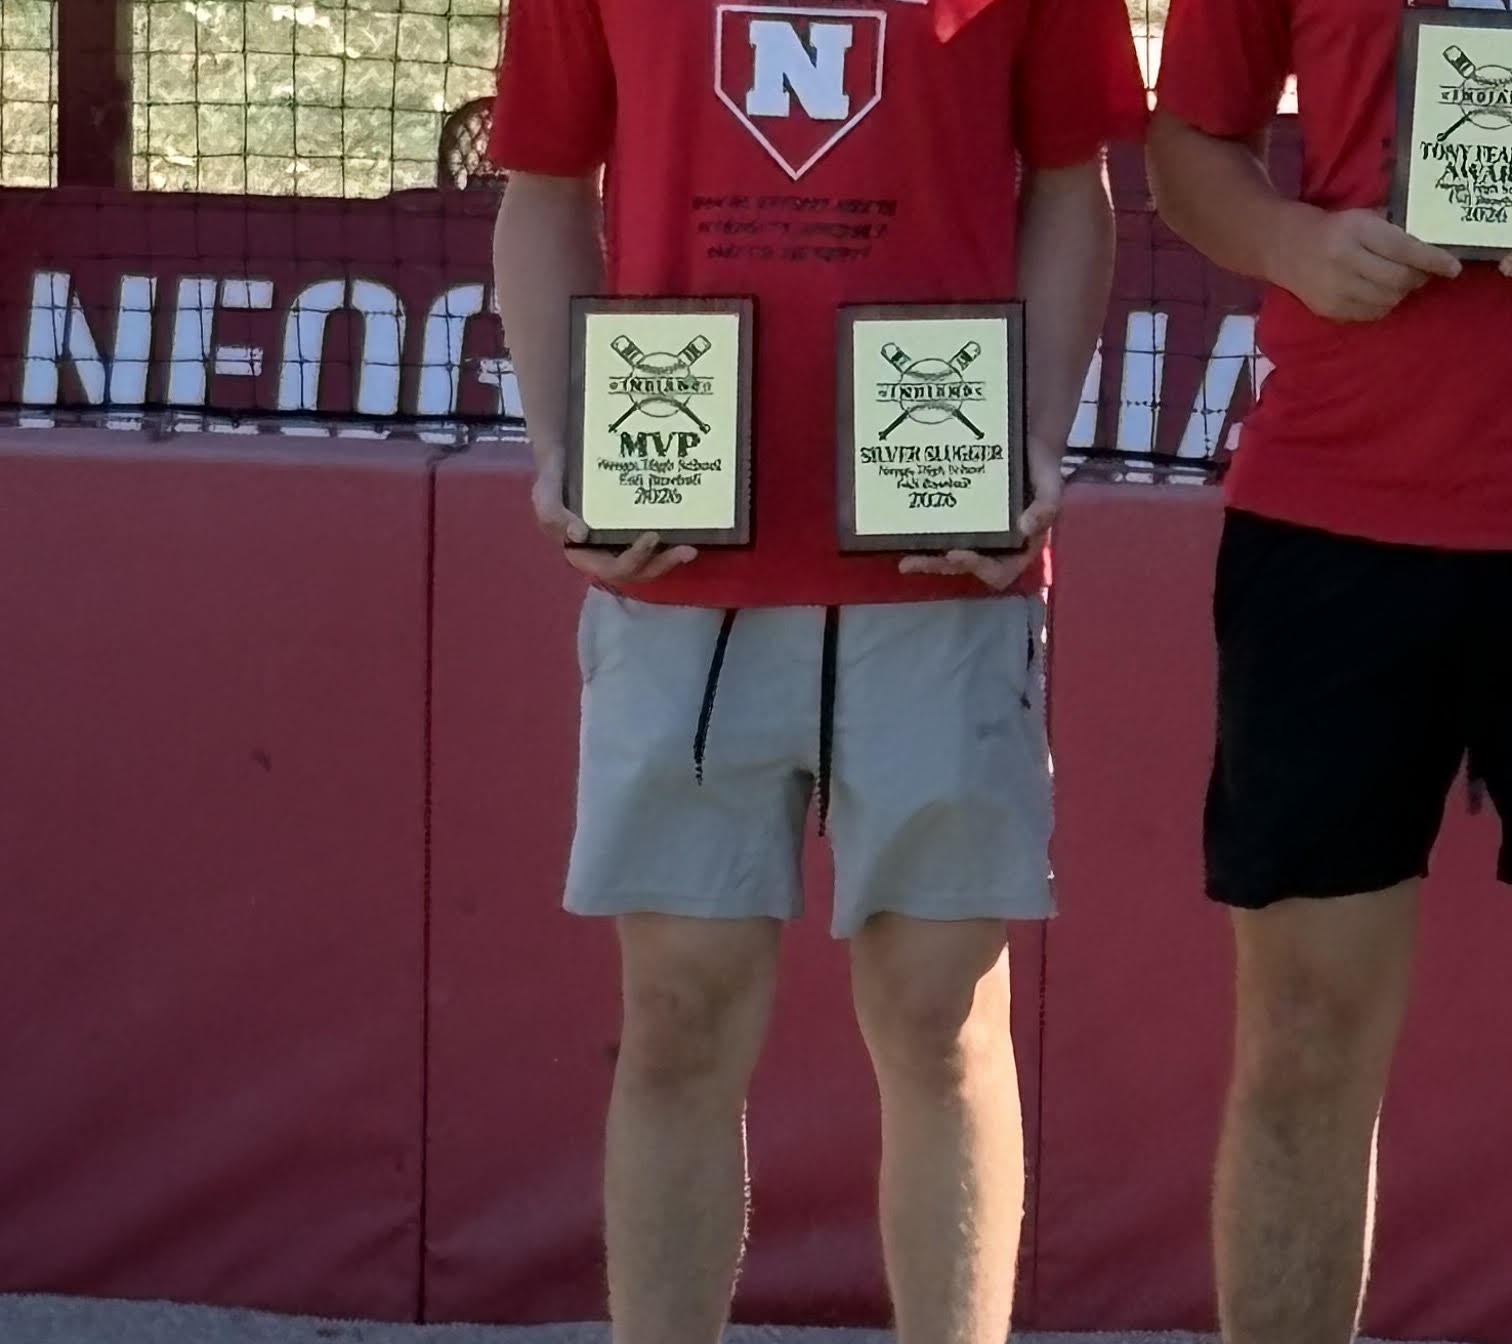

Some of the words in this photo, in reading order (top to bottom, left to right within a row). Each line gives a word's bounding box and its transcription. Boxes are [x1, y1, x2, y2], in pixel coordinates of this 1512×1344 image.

[746, 20, 853, 120] N
[18, 271, 530, 442] NEOG
[620, 431, 701, 458] MVP
